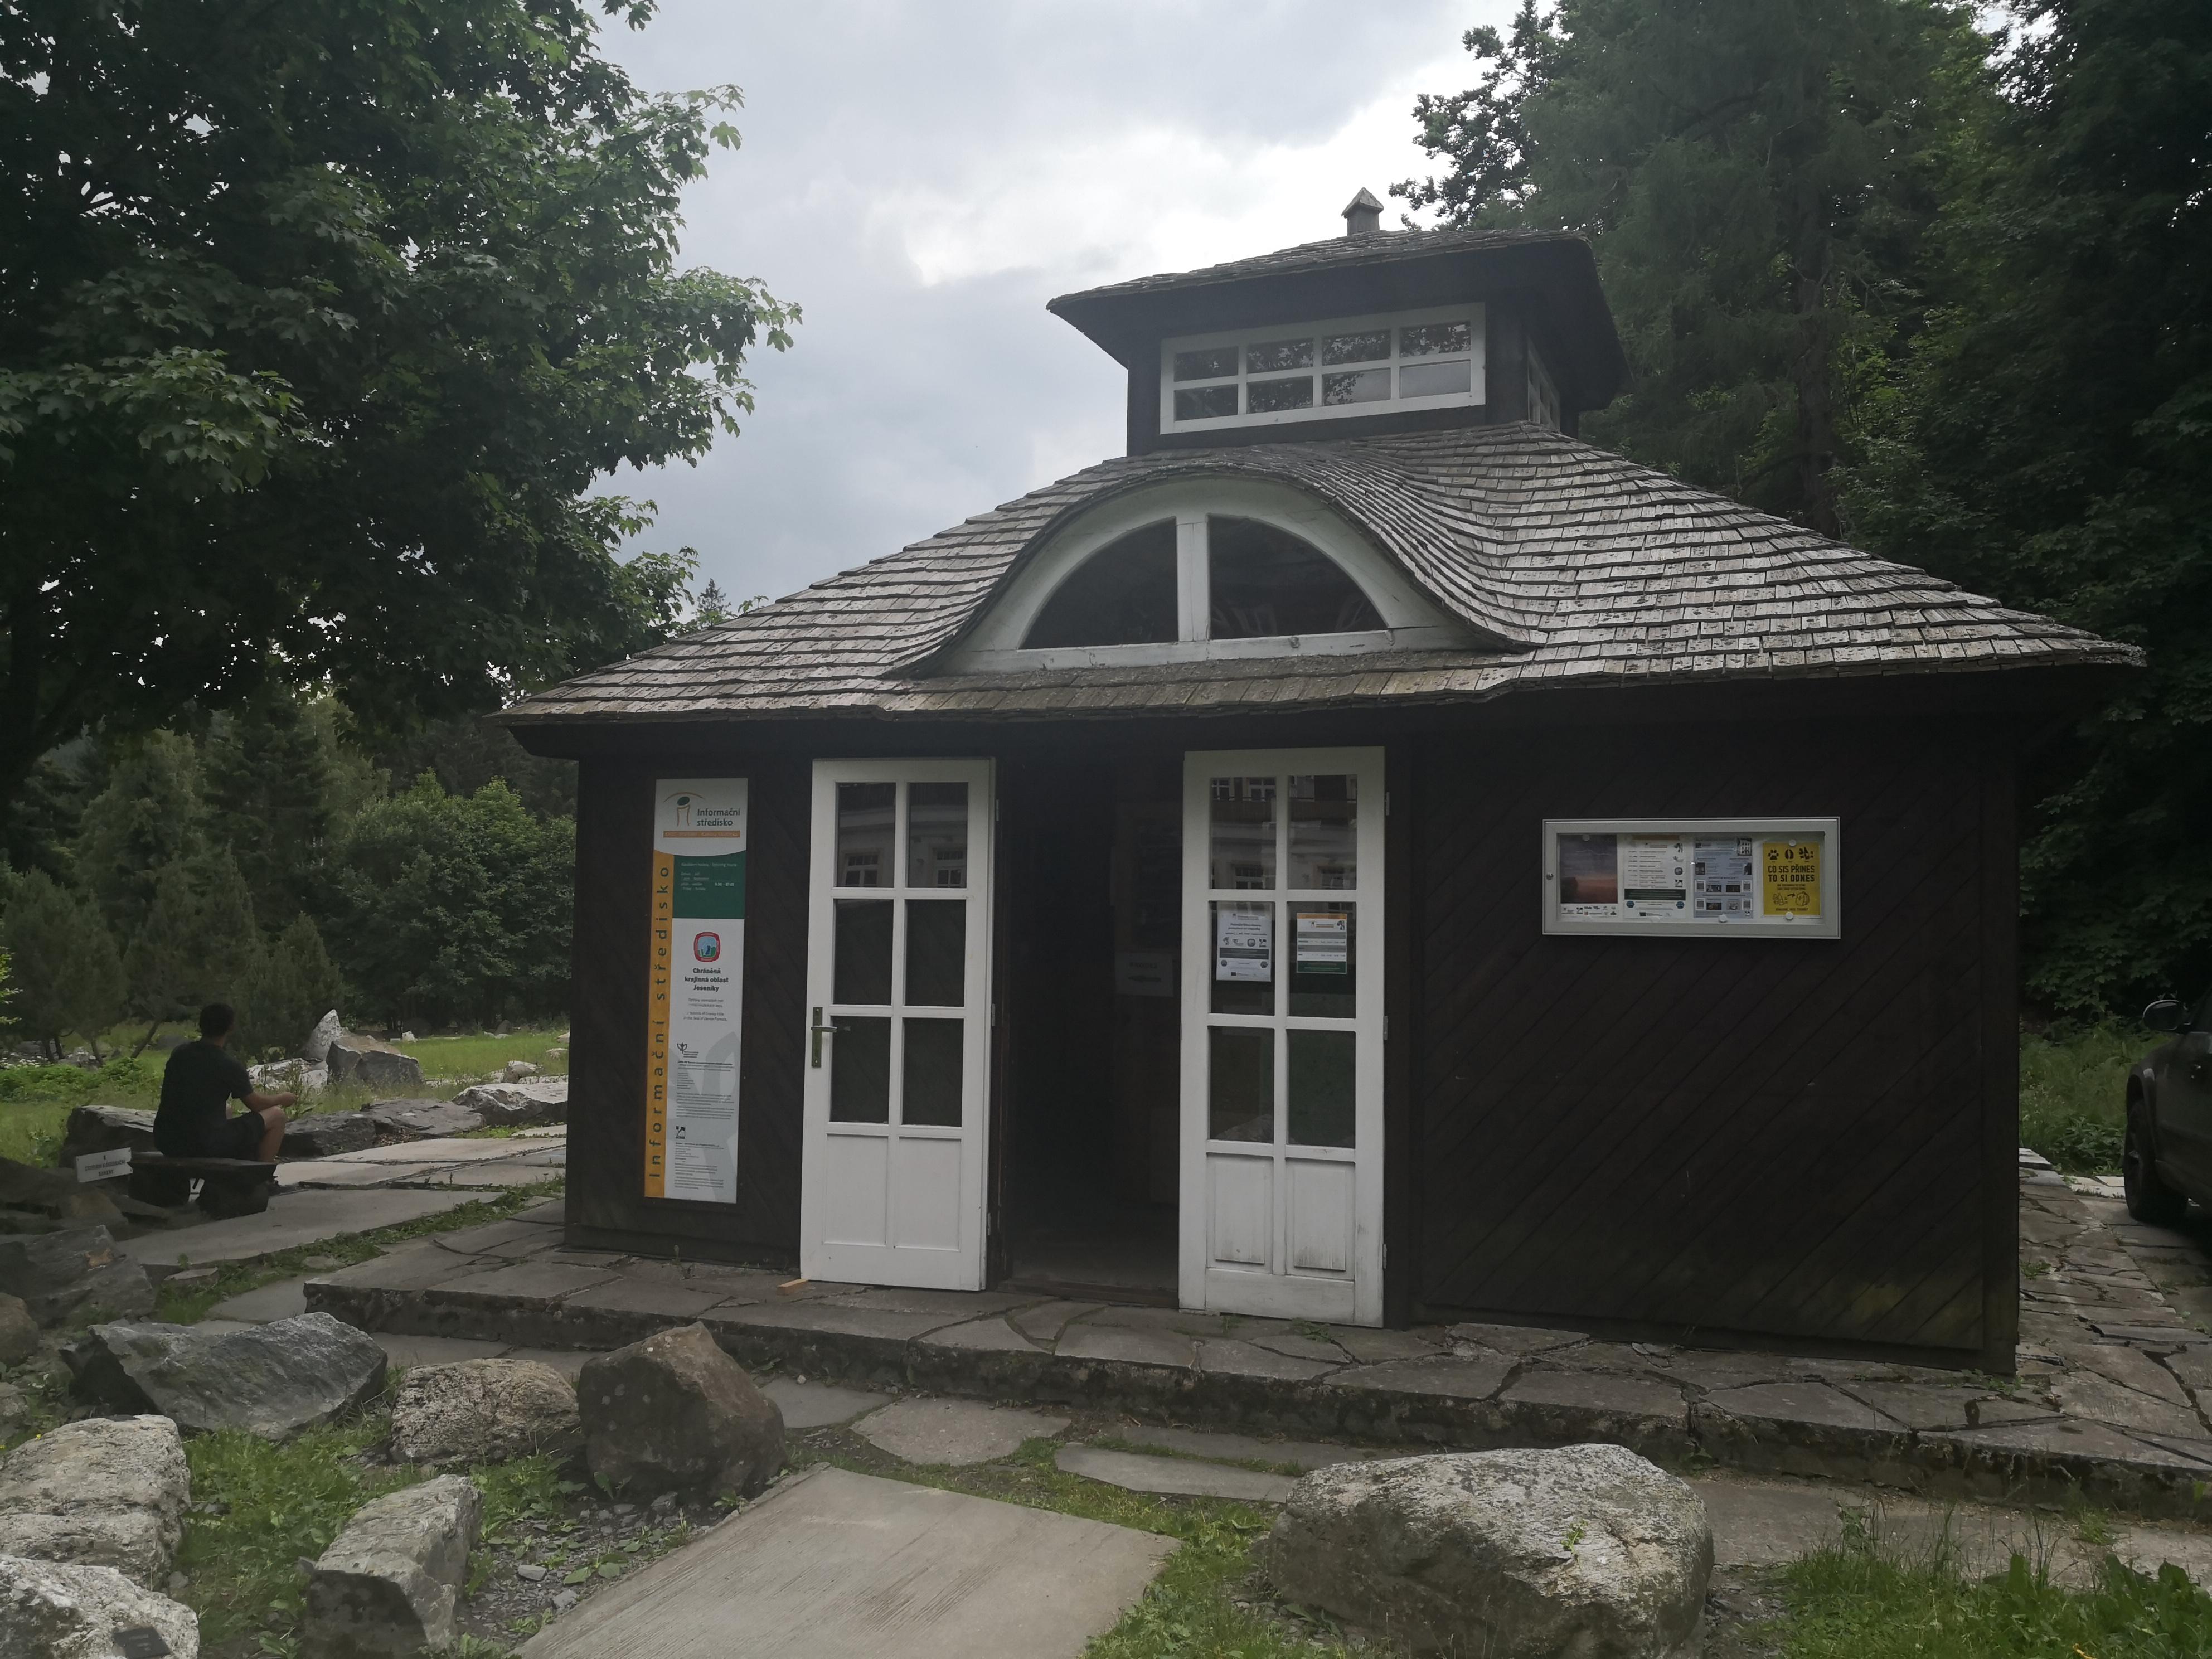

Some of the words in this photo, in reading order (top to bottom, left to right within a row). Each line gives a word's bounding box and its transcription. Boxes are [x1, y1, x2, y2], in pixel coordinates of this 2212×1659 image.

[697, 807, 740, 817] Informační
[697, 818, 733, 826] středisko
[1791, 864, 1815, 873] PŘINES
[654, 867, 669, 1000] středisko
[649, 1020, 664, 1177] Informační
